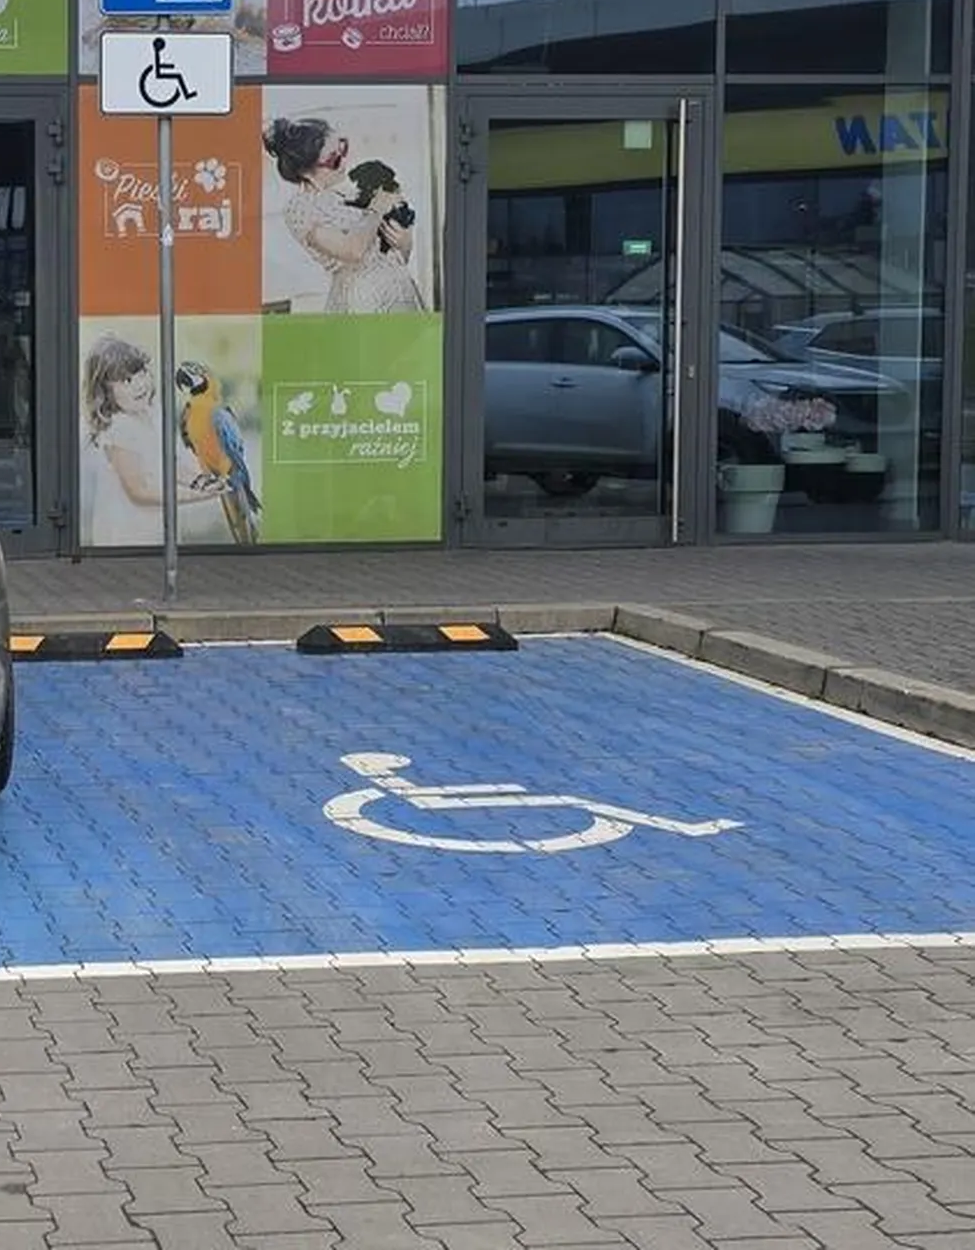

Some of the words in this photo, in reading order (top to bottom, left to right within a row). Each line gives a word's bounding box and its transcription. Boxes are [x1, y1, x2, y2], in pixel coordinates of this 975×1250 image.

[178, 198, 232, 238] raj
[282, 419, 295, 436] Z
[299, 419, 420, 439] przyjacielem
